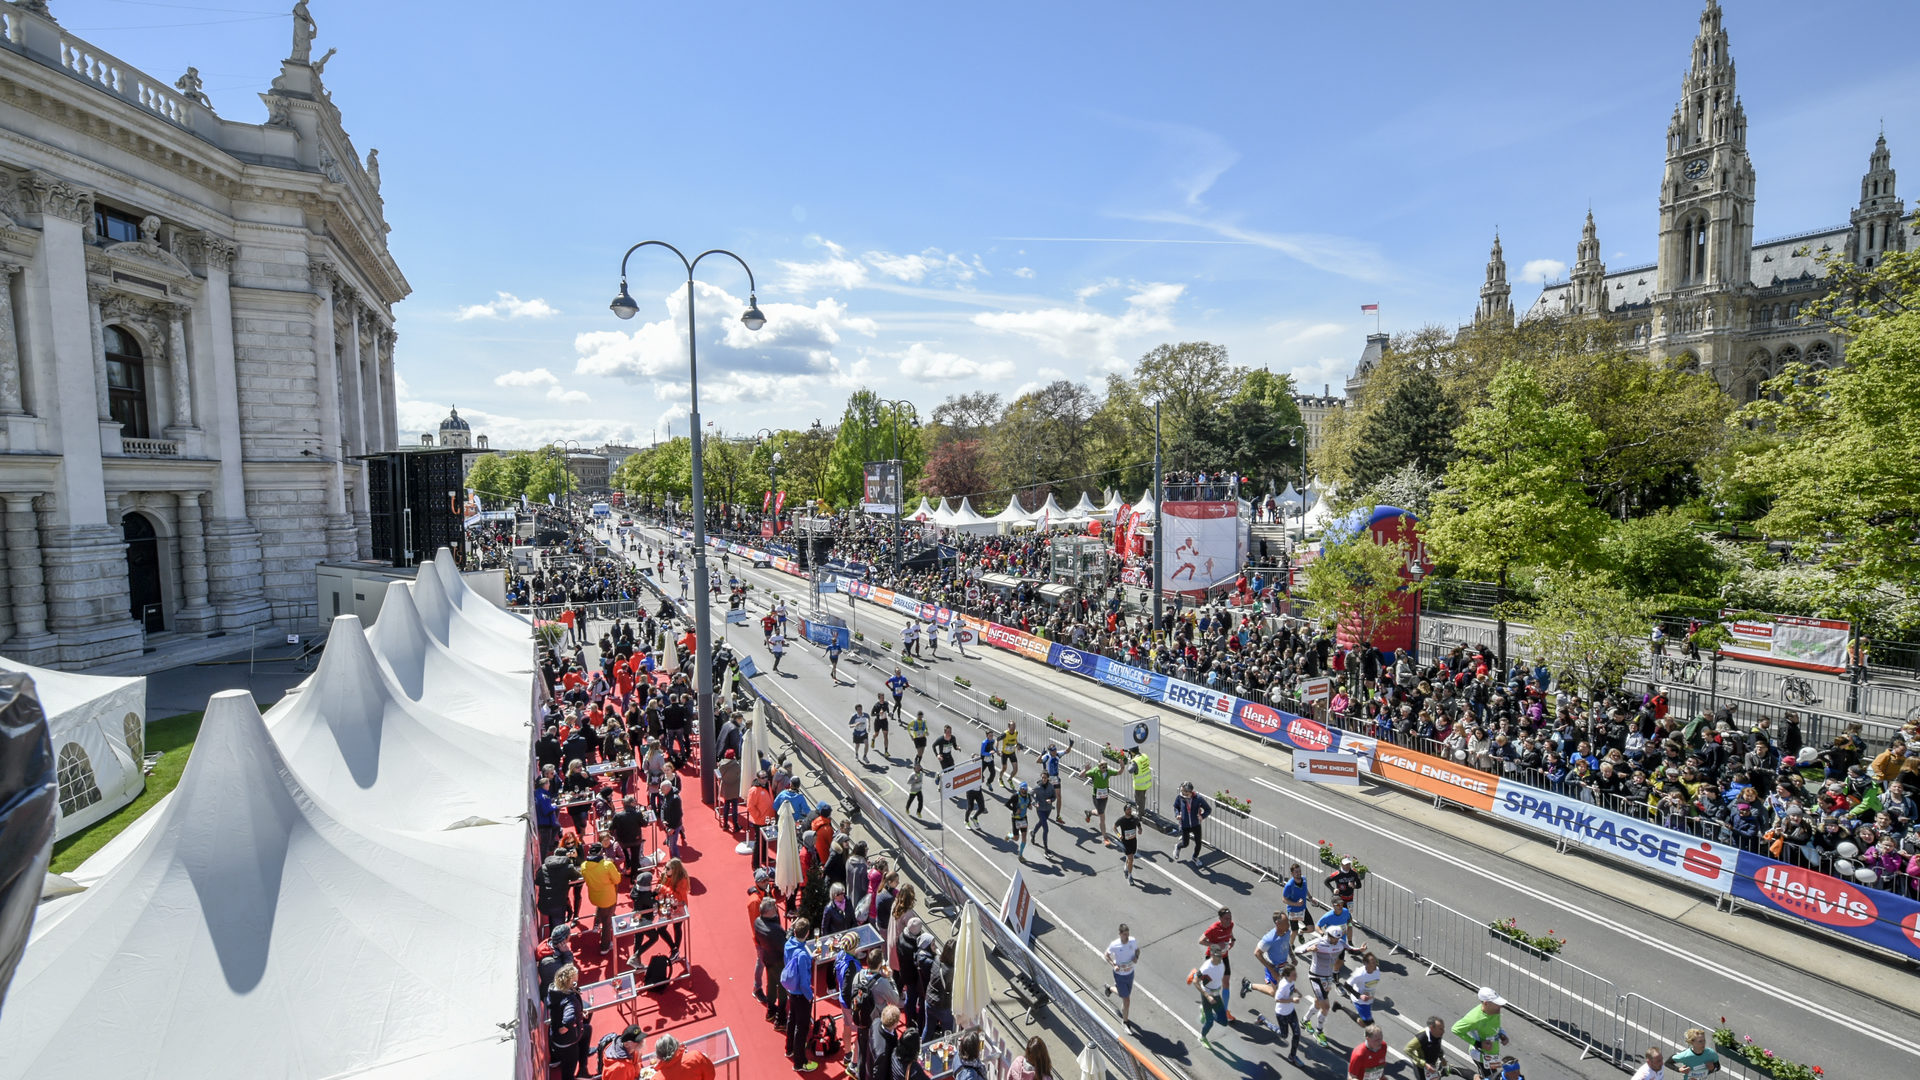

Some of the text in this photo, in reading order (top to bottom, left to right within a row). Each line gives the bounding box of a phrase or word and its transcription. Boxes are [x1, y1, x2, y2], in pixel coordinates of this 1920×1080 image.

[988, 627, 1049, 655] INFOSCREEN
[1108, 661, 1143, 684] ERDINGER
[1168, 684, 1216, 713] ERSTE
[1243, 705, 1279, 729] Hervis
[1291, 720, 1330, 746] Hervis
[1380, 752, 1489, 794] WIEN ENERGIE
[1503, 791, 1681, 867] SPARKASSE
[1763, 867, 1869, 921] Hervis
[1770, 892, 1818, 913] SPORTS
